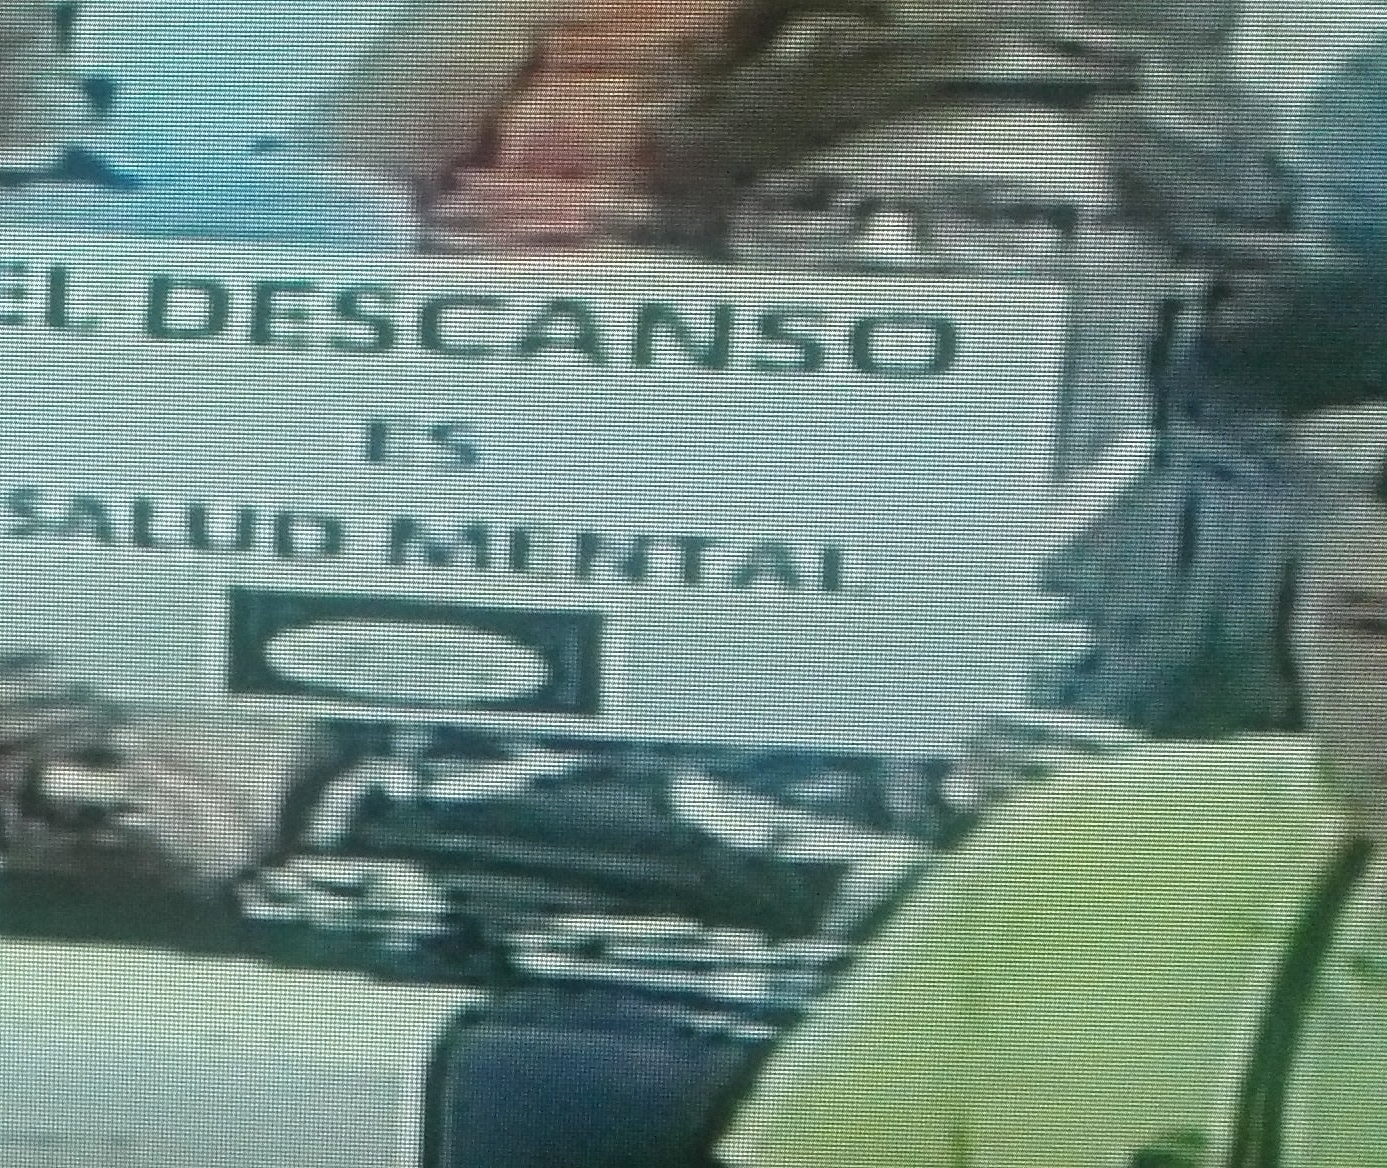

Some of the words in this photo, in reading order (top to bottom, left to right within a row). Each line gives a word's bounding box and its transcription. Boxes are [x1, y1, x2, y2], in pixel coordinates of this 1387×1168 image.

[140, 271, 962, 383] DESCANSO
[358, 414, 484, 477] ES
[0, 480, 353, 570] SALUD
[380, 510, 871, 602] MENTAL
